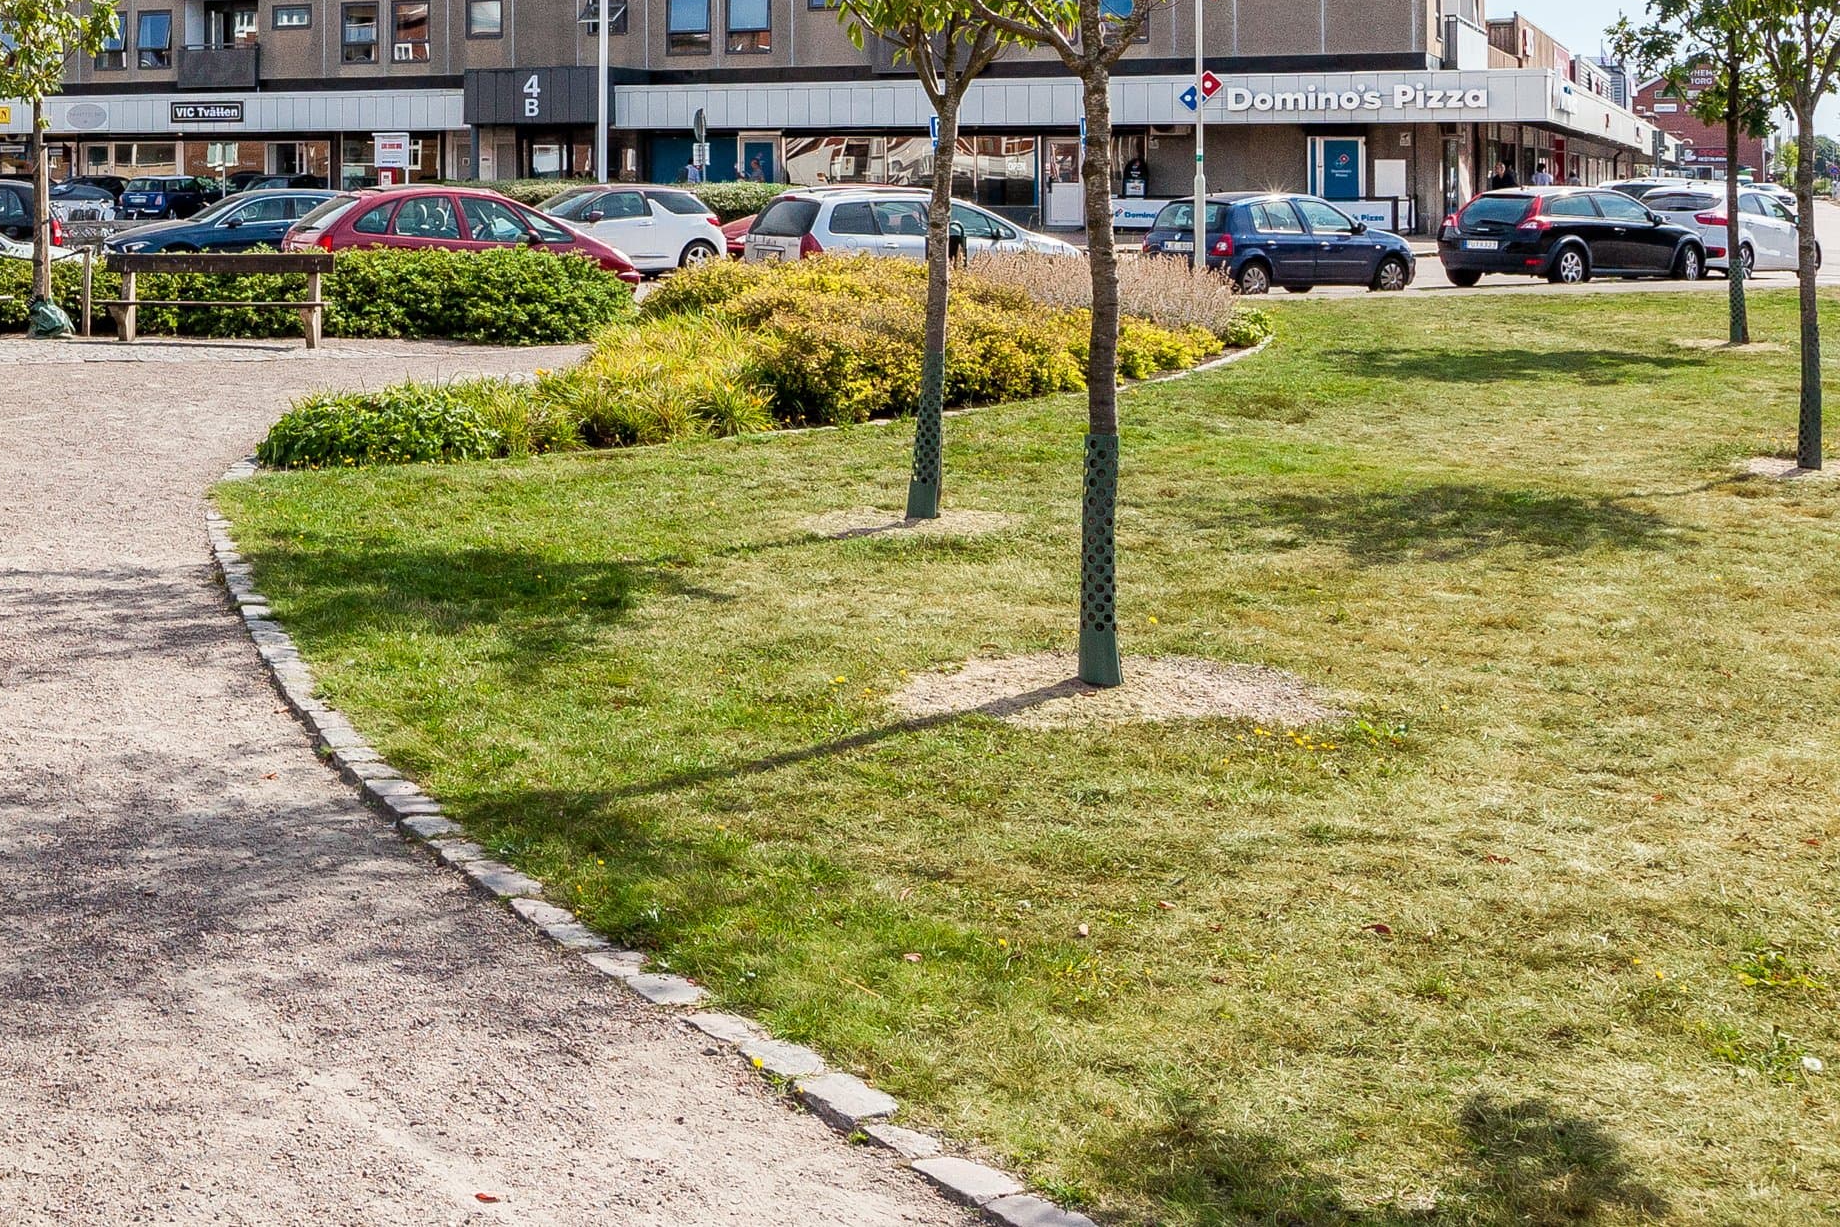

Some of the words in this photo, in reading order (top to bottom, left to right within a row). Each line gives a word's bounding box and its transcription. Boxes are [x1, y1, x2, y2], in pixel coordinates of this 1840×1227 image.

[523, 75, 541, 97] 4
[1227, 84, 1382, 111] Domino's
[1393, 82, 1488, 109] Pizza
[175, 107, 195, 118] VIC
[197, 107, 238, 117] Tvätten
[525, 99, 539, 116] B
